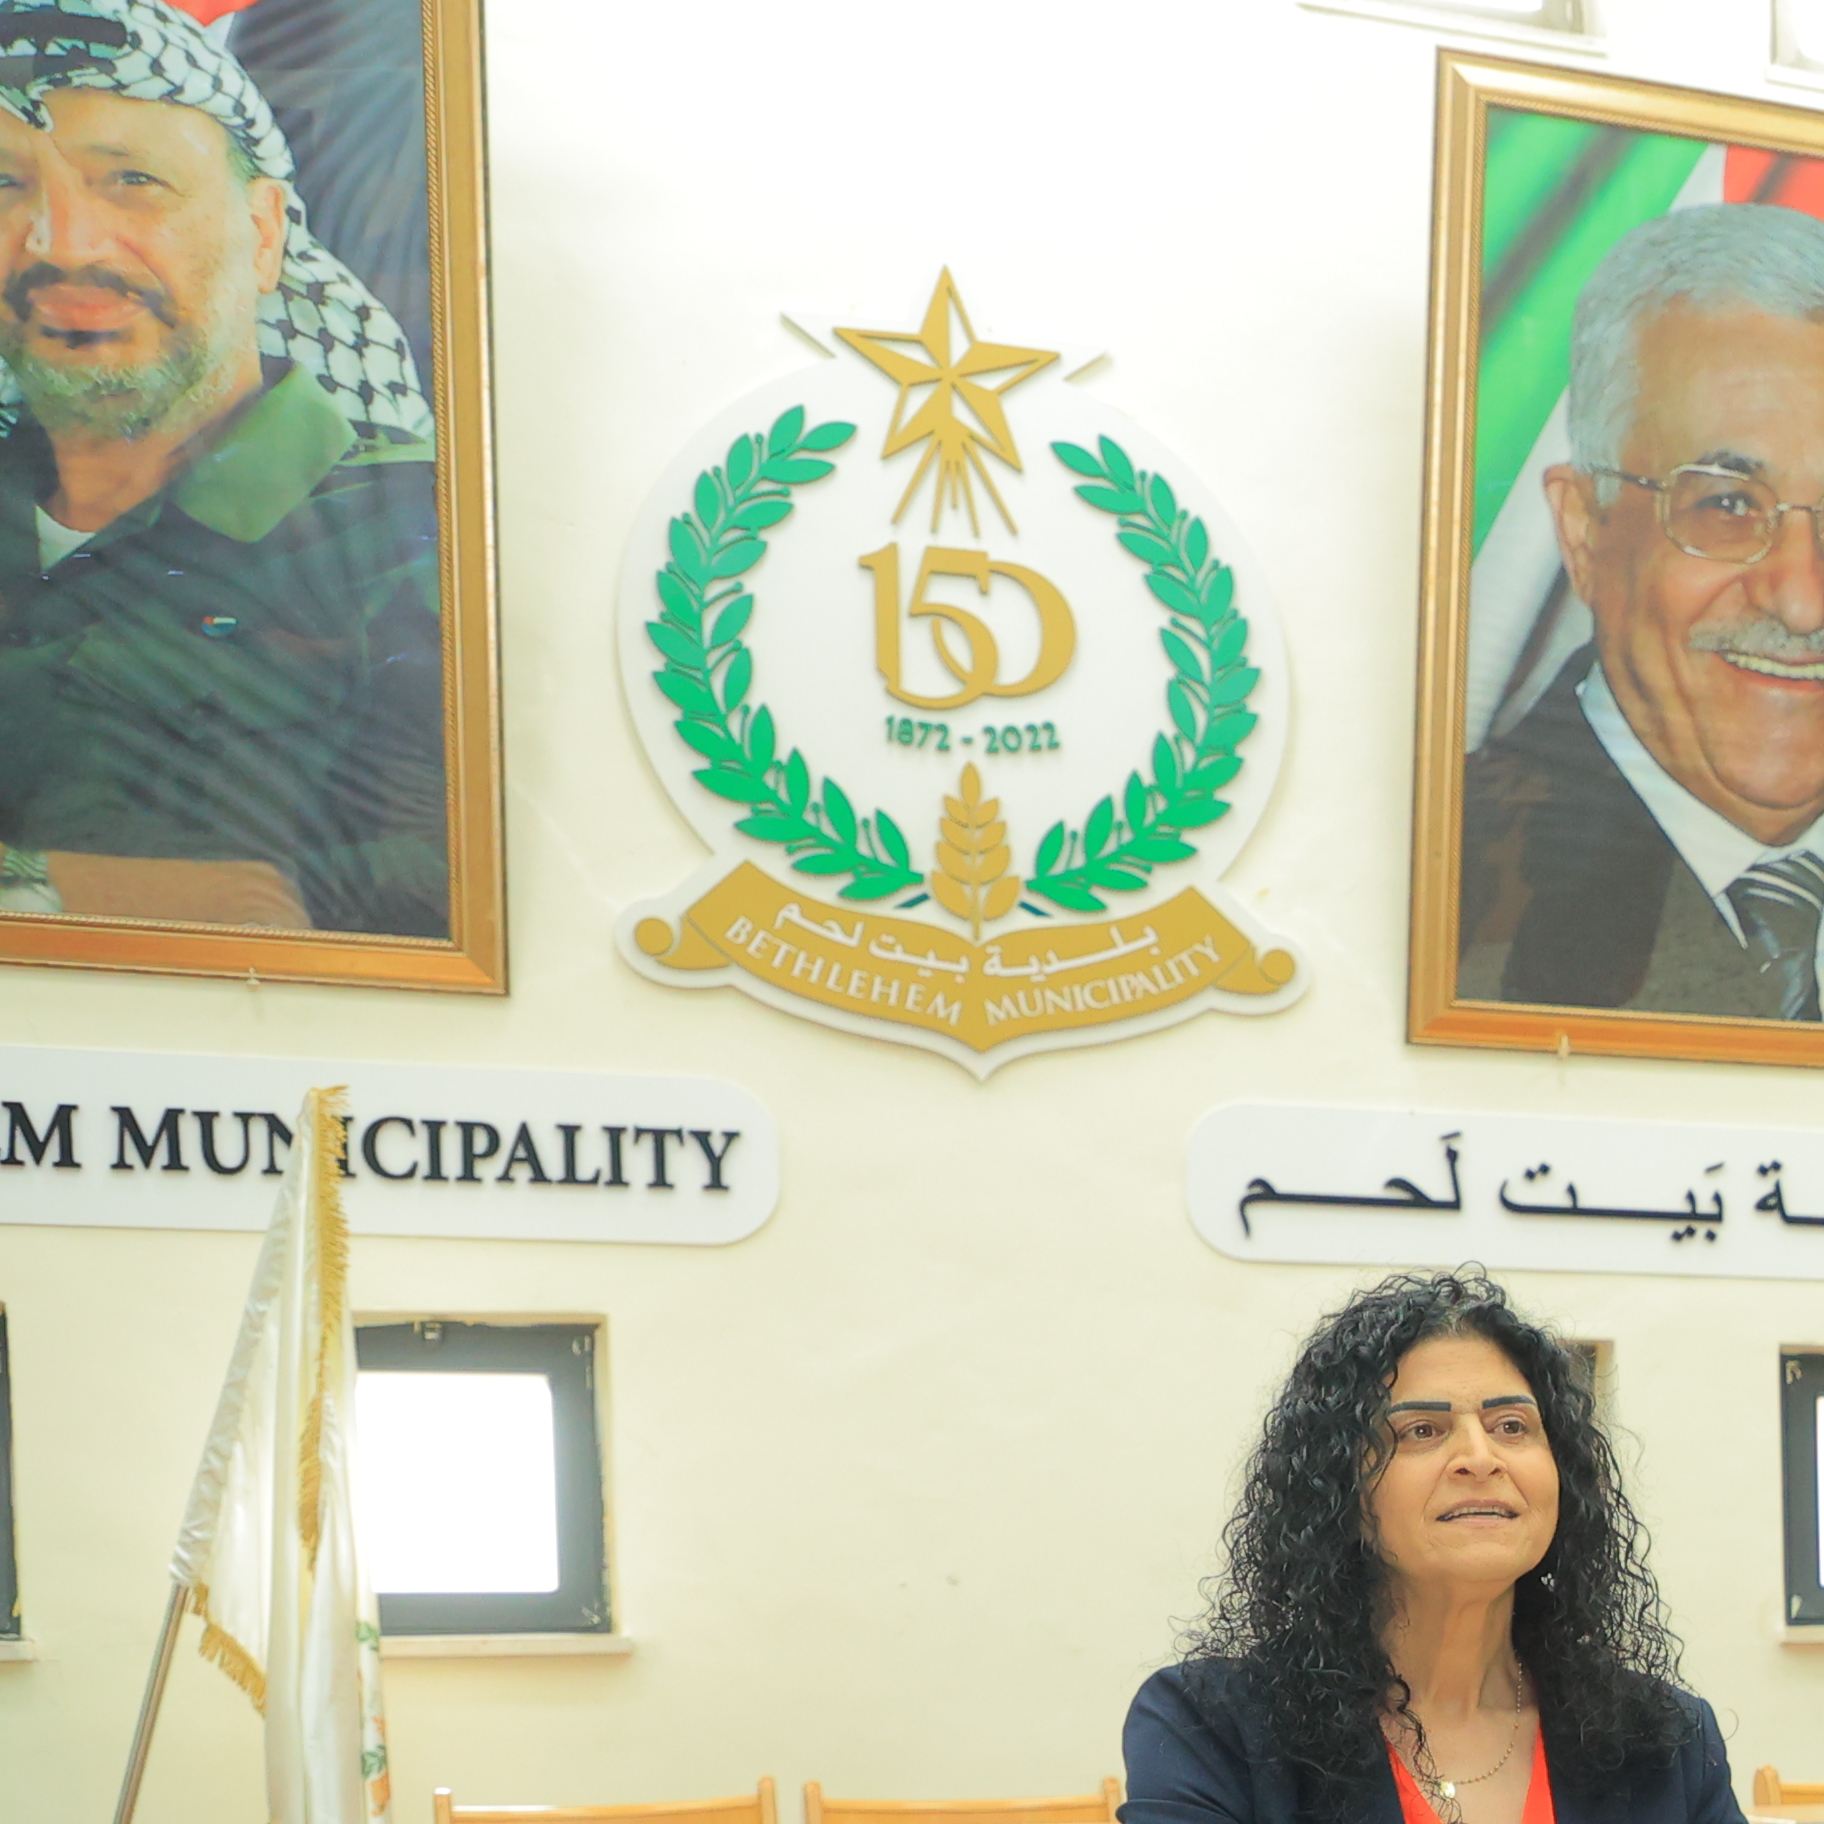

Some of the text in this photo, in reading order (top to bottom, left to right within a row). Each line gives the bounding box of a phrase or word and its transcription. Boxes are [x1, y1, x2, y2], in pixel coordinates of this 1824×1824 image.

[858, 541, 1077, 710] 150
[886, 714, 951, 751] 1872
[981, 720, 1060, 754] 2022
[724, 915, 1222, 1028] BETHLEHEM MUNICIPALITY
[774, 900, 1159, 984] بلدية بيت لحم
[0, 1101, 82, 1169] M
